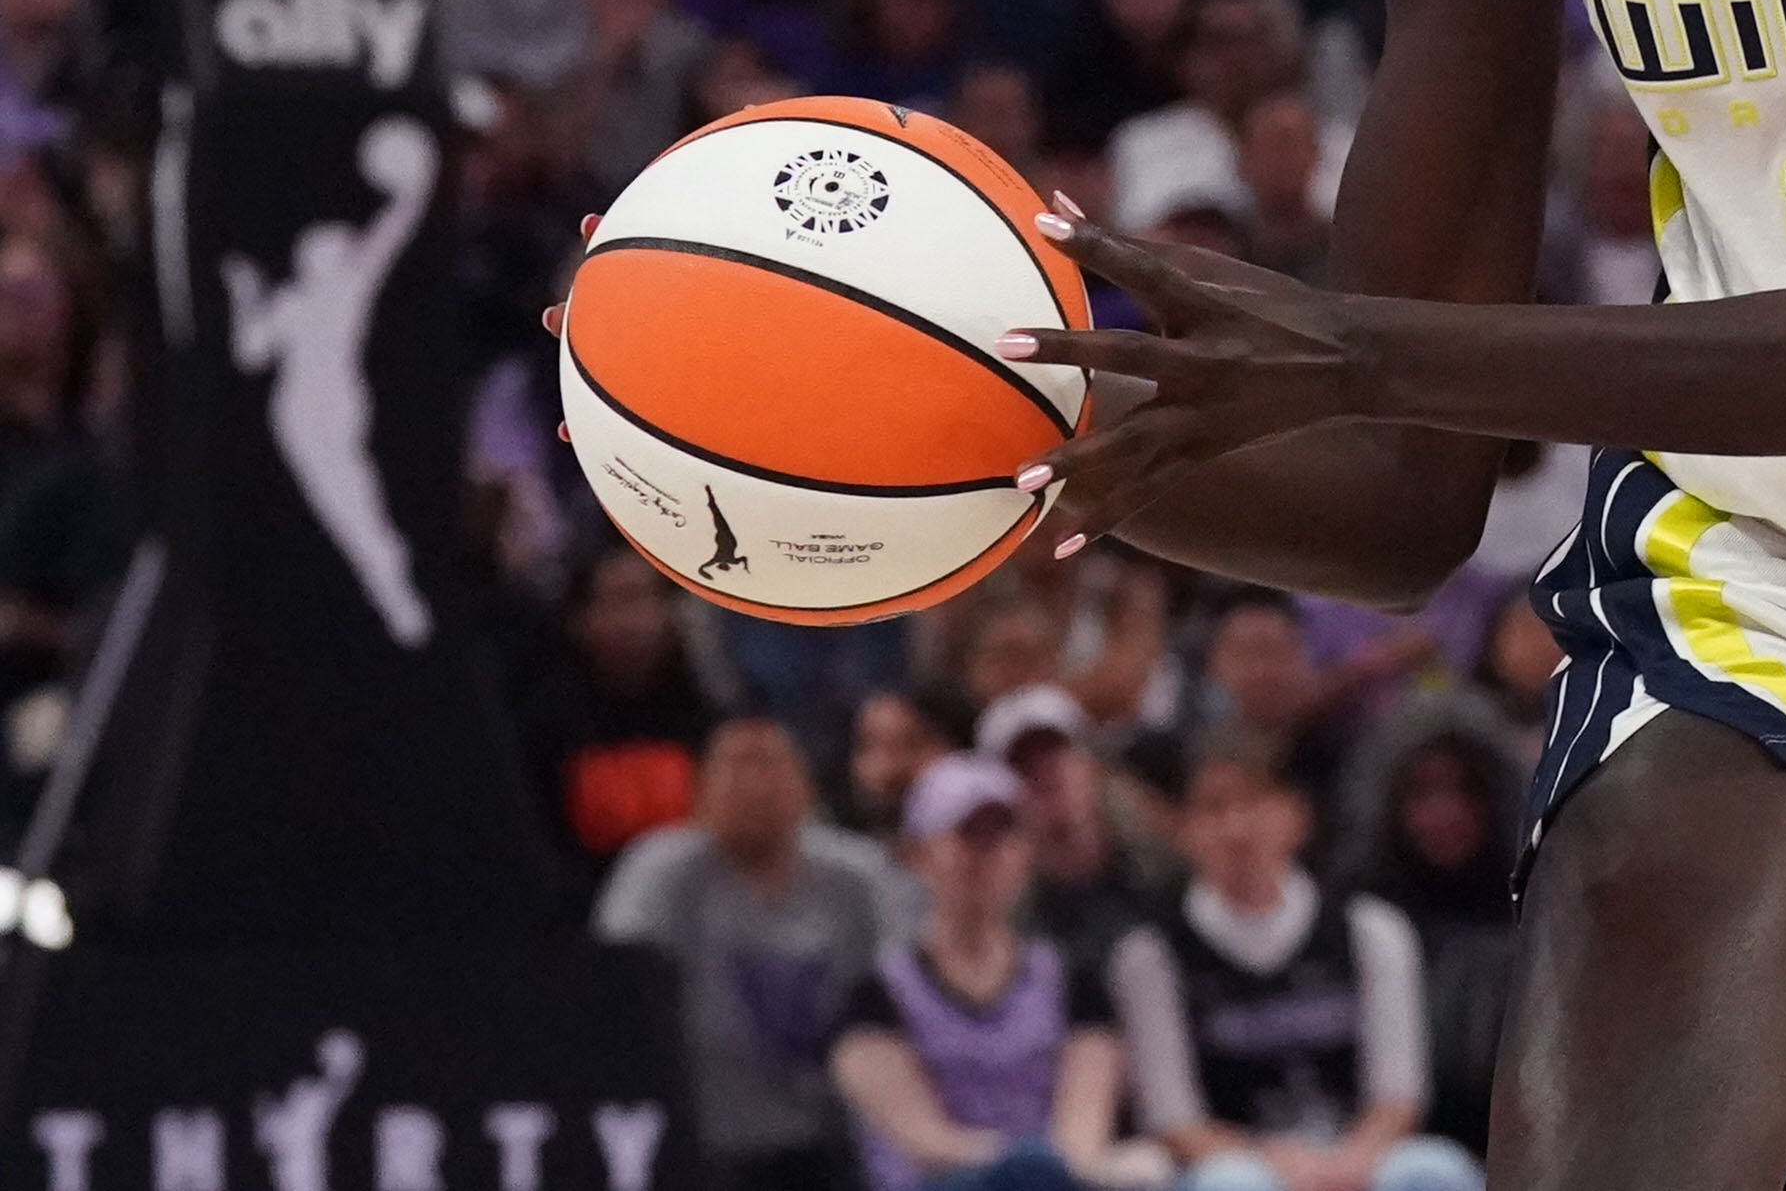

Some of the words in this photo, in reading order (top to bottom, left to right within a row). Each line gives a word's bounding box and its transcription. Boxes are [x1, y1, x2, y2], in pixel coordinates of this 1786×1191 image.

[768, 540, 820, 552] BALL
[825, 541, 885, 553] GAME
[783, 553, 871, 564] OFFICIAL
